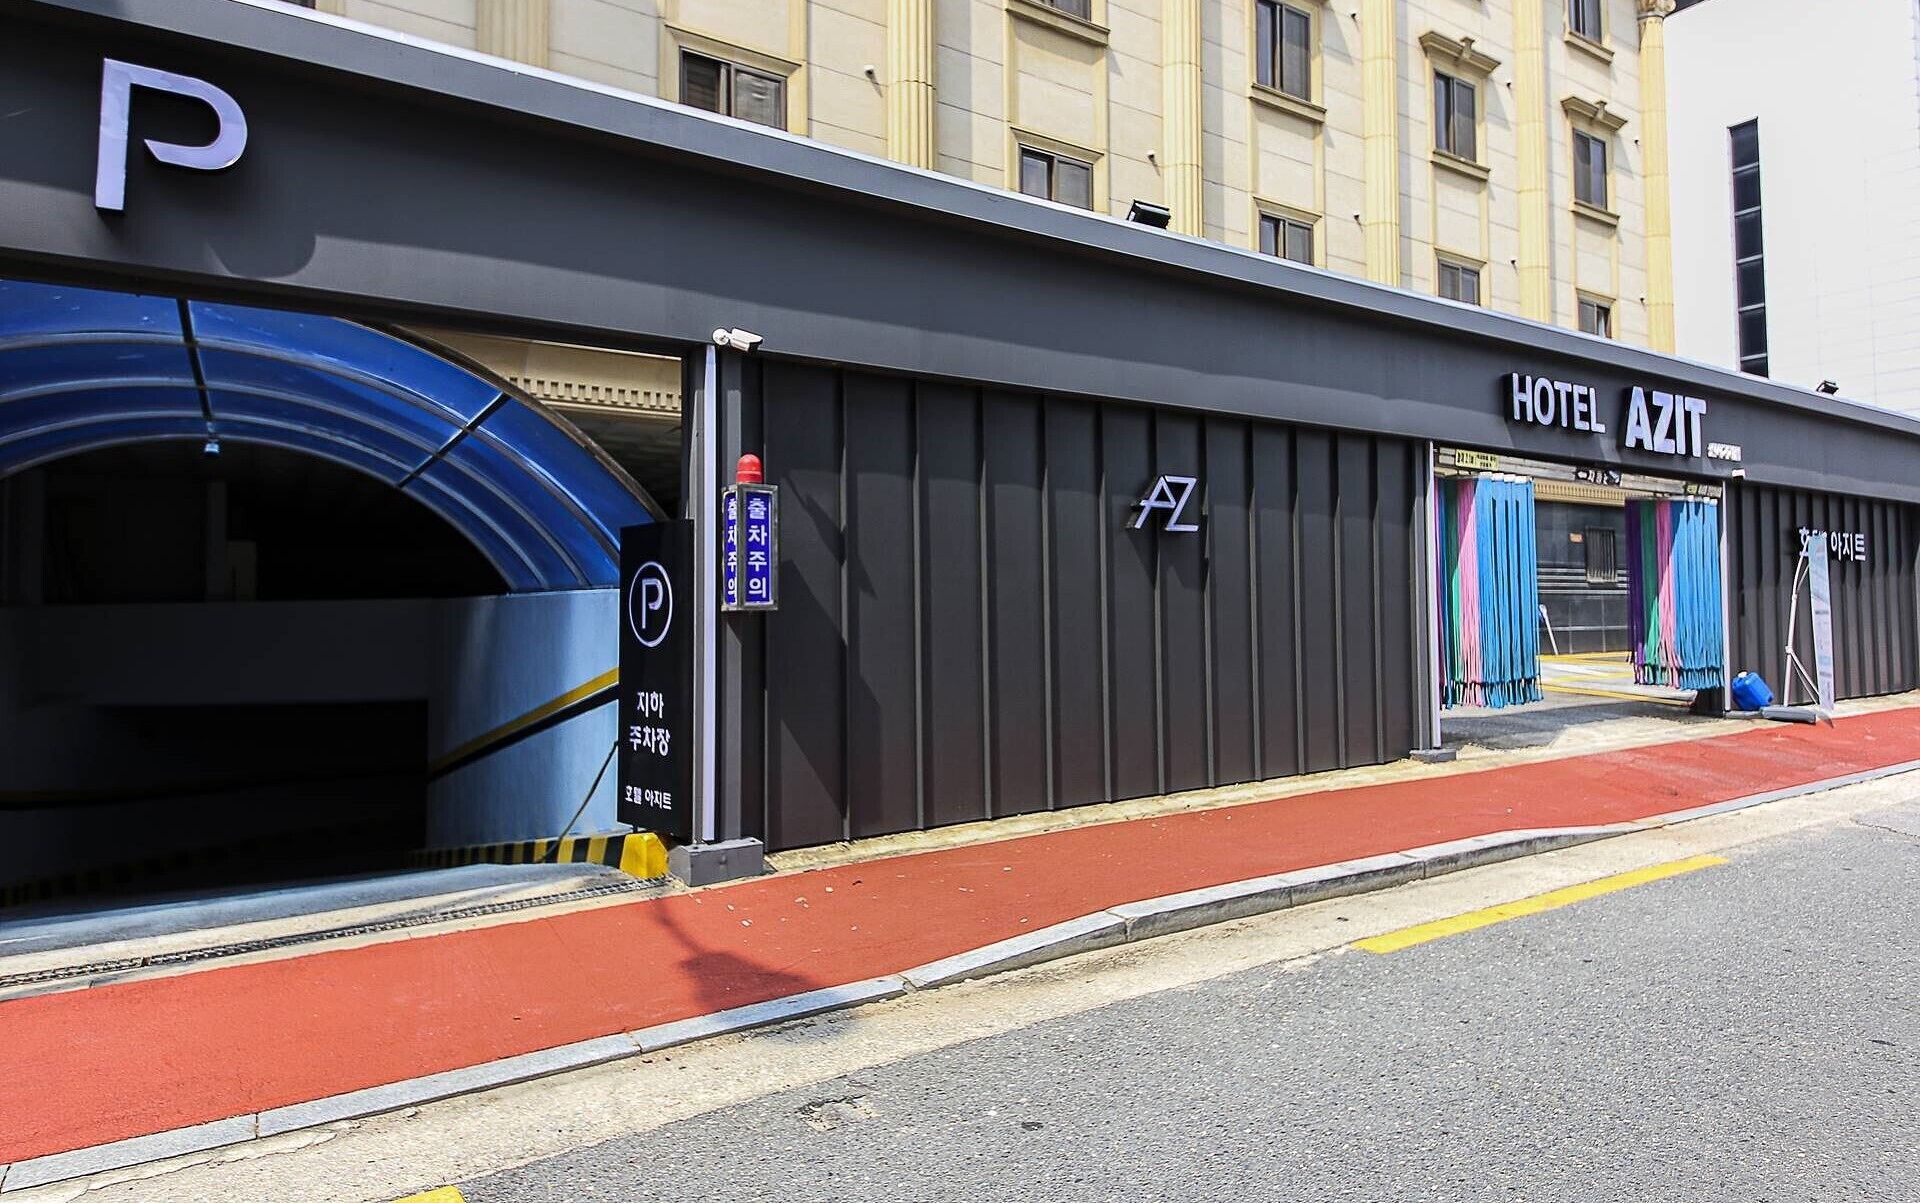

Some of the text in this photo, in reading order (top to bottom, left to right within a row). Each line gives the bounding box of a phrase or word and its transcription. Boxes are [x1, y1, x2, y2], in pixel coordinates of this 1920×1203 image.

[95, 57, 248, 211] P
[1511, 372, 1707, 458] HOTEL AZIT
[1134, 475, 1199, 532] AZ
[747, 497, 768, 599] 출차주의
[1799, 526, 1866, 562] 호 아지트
[637, 691, 664, 719] 지하
[629, 725, 671, 757] 주차장
[624, 785, 672, 810] 호텔 아지트
